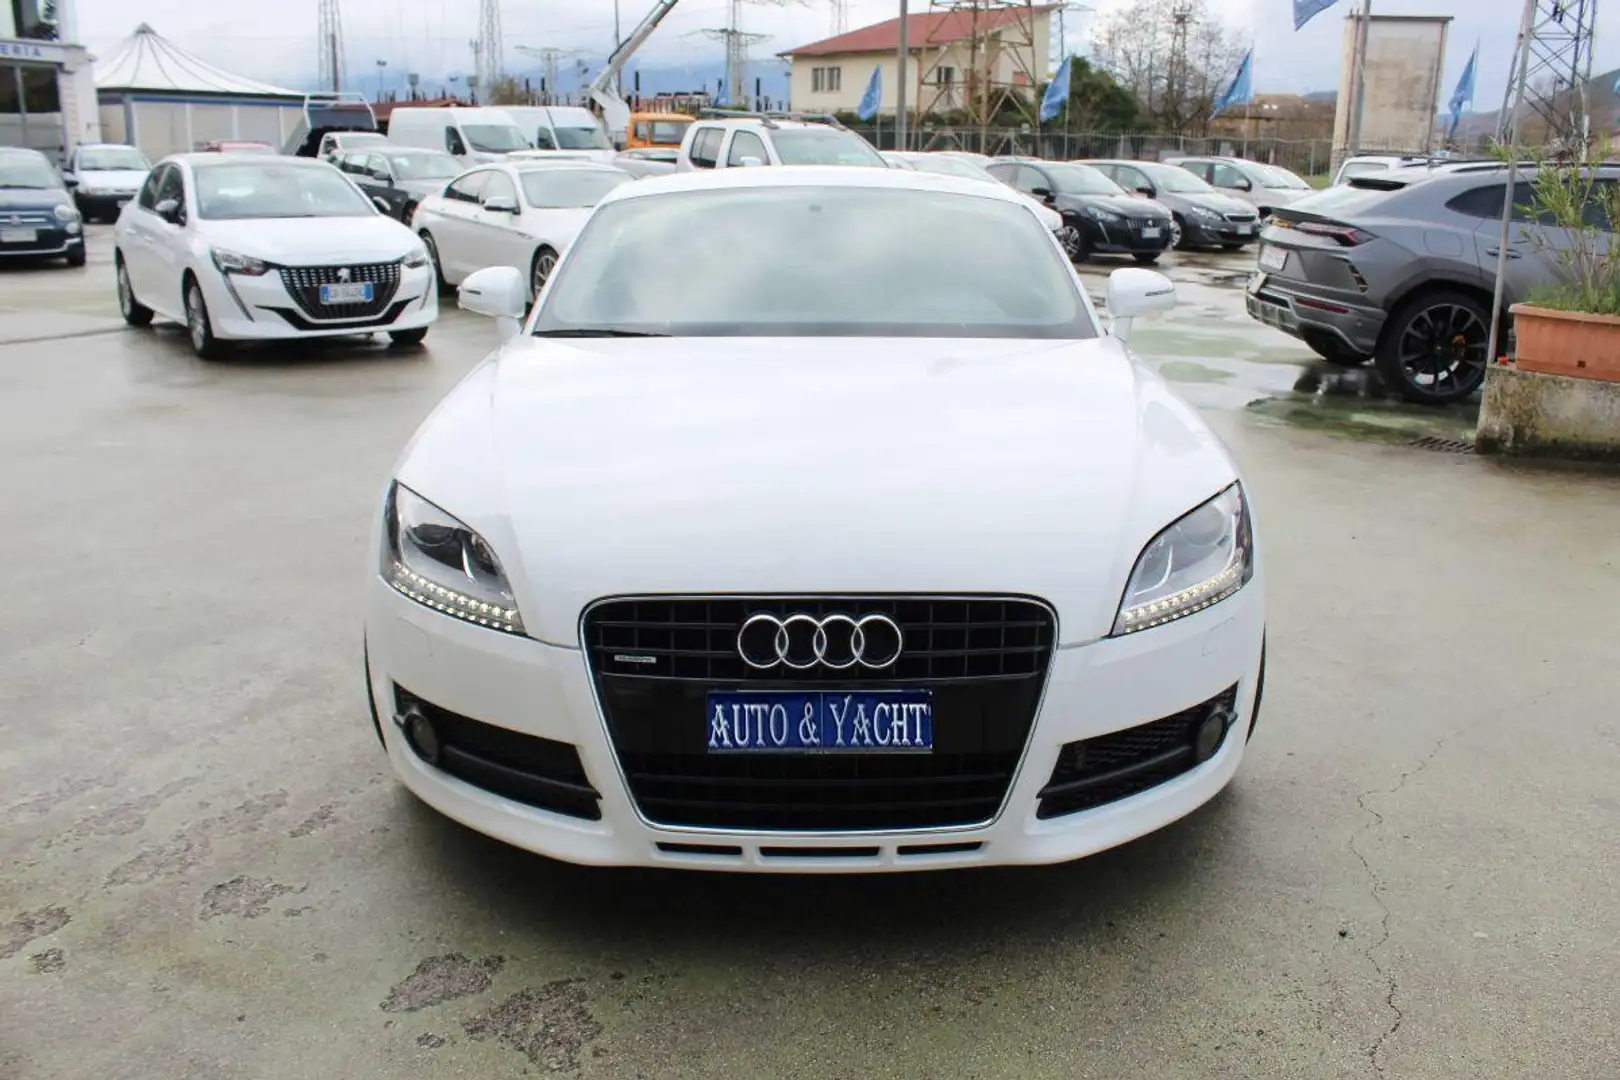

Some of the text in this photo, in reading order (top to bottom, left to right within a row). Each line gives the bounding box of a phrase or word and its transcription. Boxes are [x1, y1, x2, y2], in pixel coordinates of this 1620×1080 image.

[709, 694, 928, 747] AUTO & YACHT
